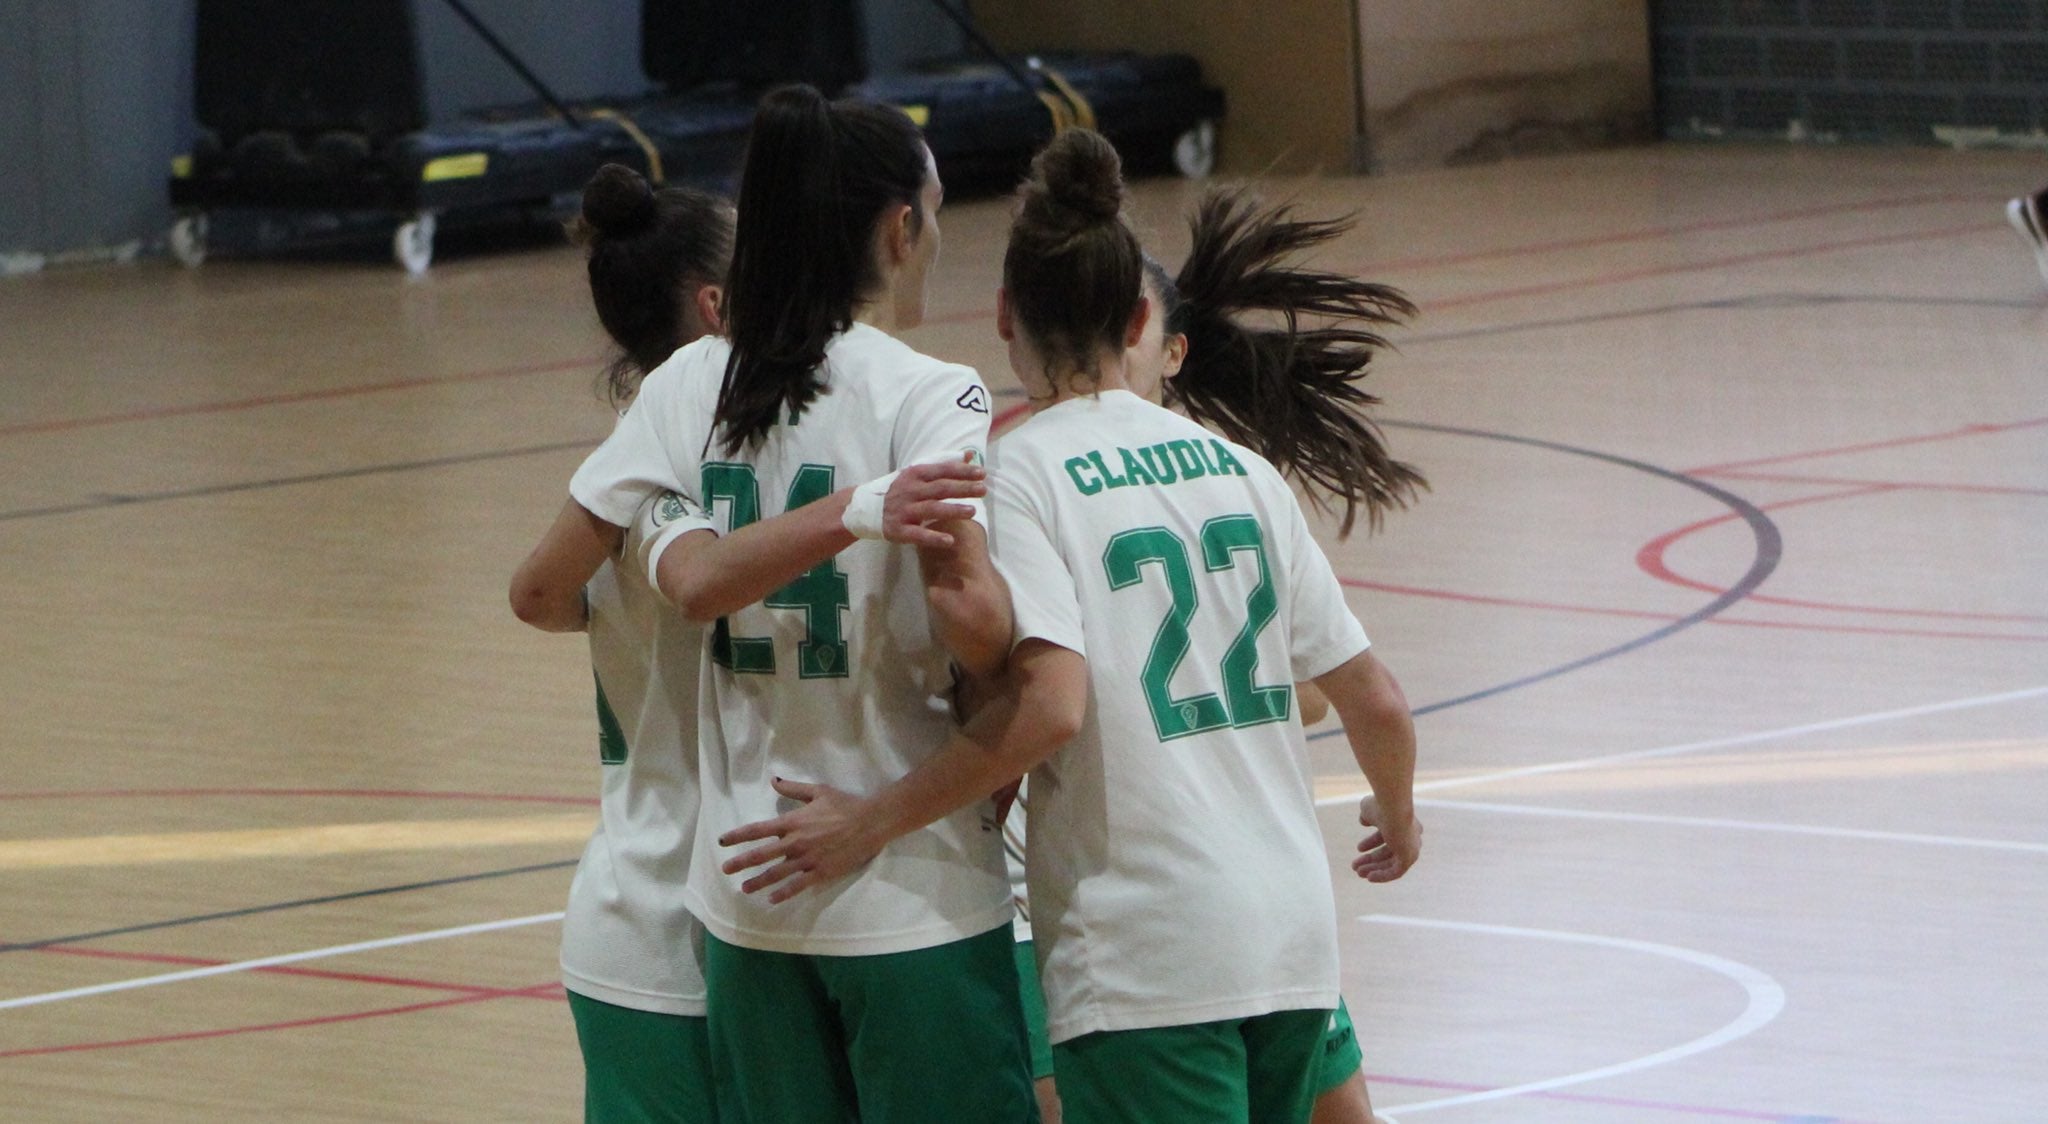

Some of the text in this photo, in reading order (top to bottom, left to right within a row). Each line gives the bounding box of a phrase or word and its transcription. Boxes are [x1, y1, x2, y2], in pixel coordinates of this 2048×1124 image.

[701, 461, 850, 679] 24
[1064, 438, 1248, 496] CLAUDIA
[1102, 513, 1292, 743] 22
